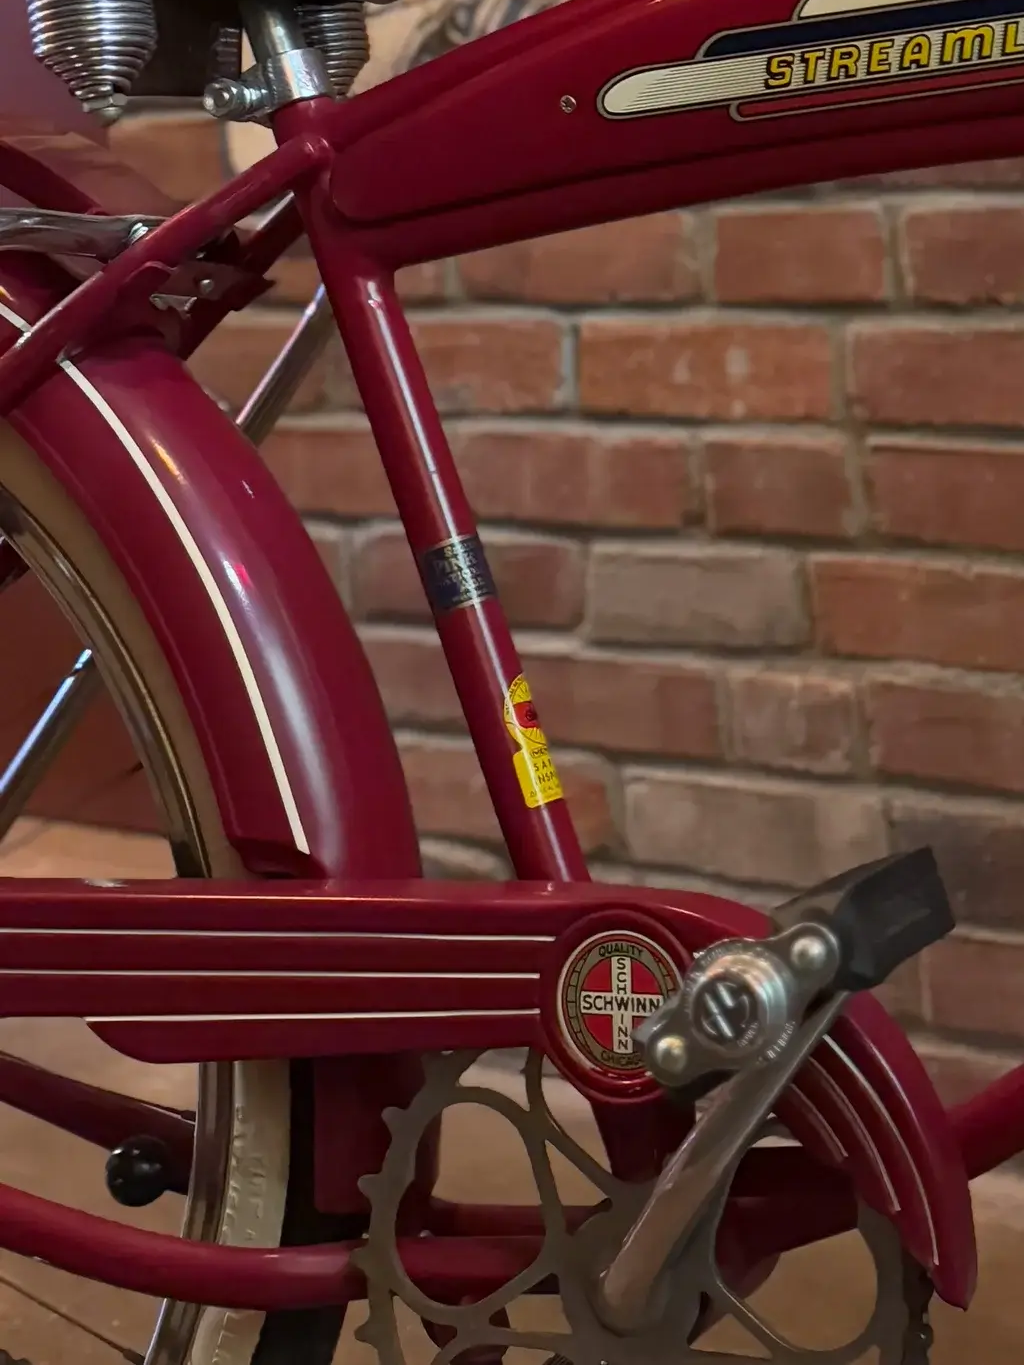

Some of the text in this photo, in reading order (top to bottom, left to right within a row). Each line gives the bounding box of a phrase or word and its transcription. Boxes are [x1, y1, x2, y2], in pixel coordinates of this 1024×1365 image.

[599, 943, 644, 957] QUALITY
[582, 994, 660, 1013] SCHWINN
[615, 957, 630, 1050] SCHWINN
